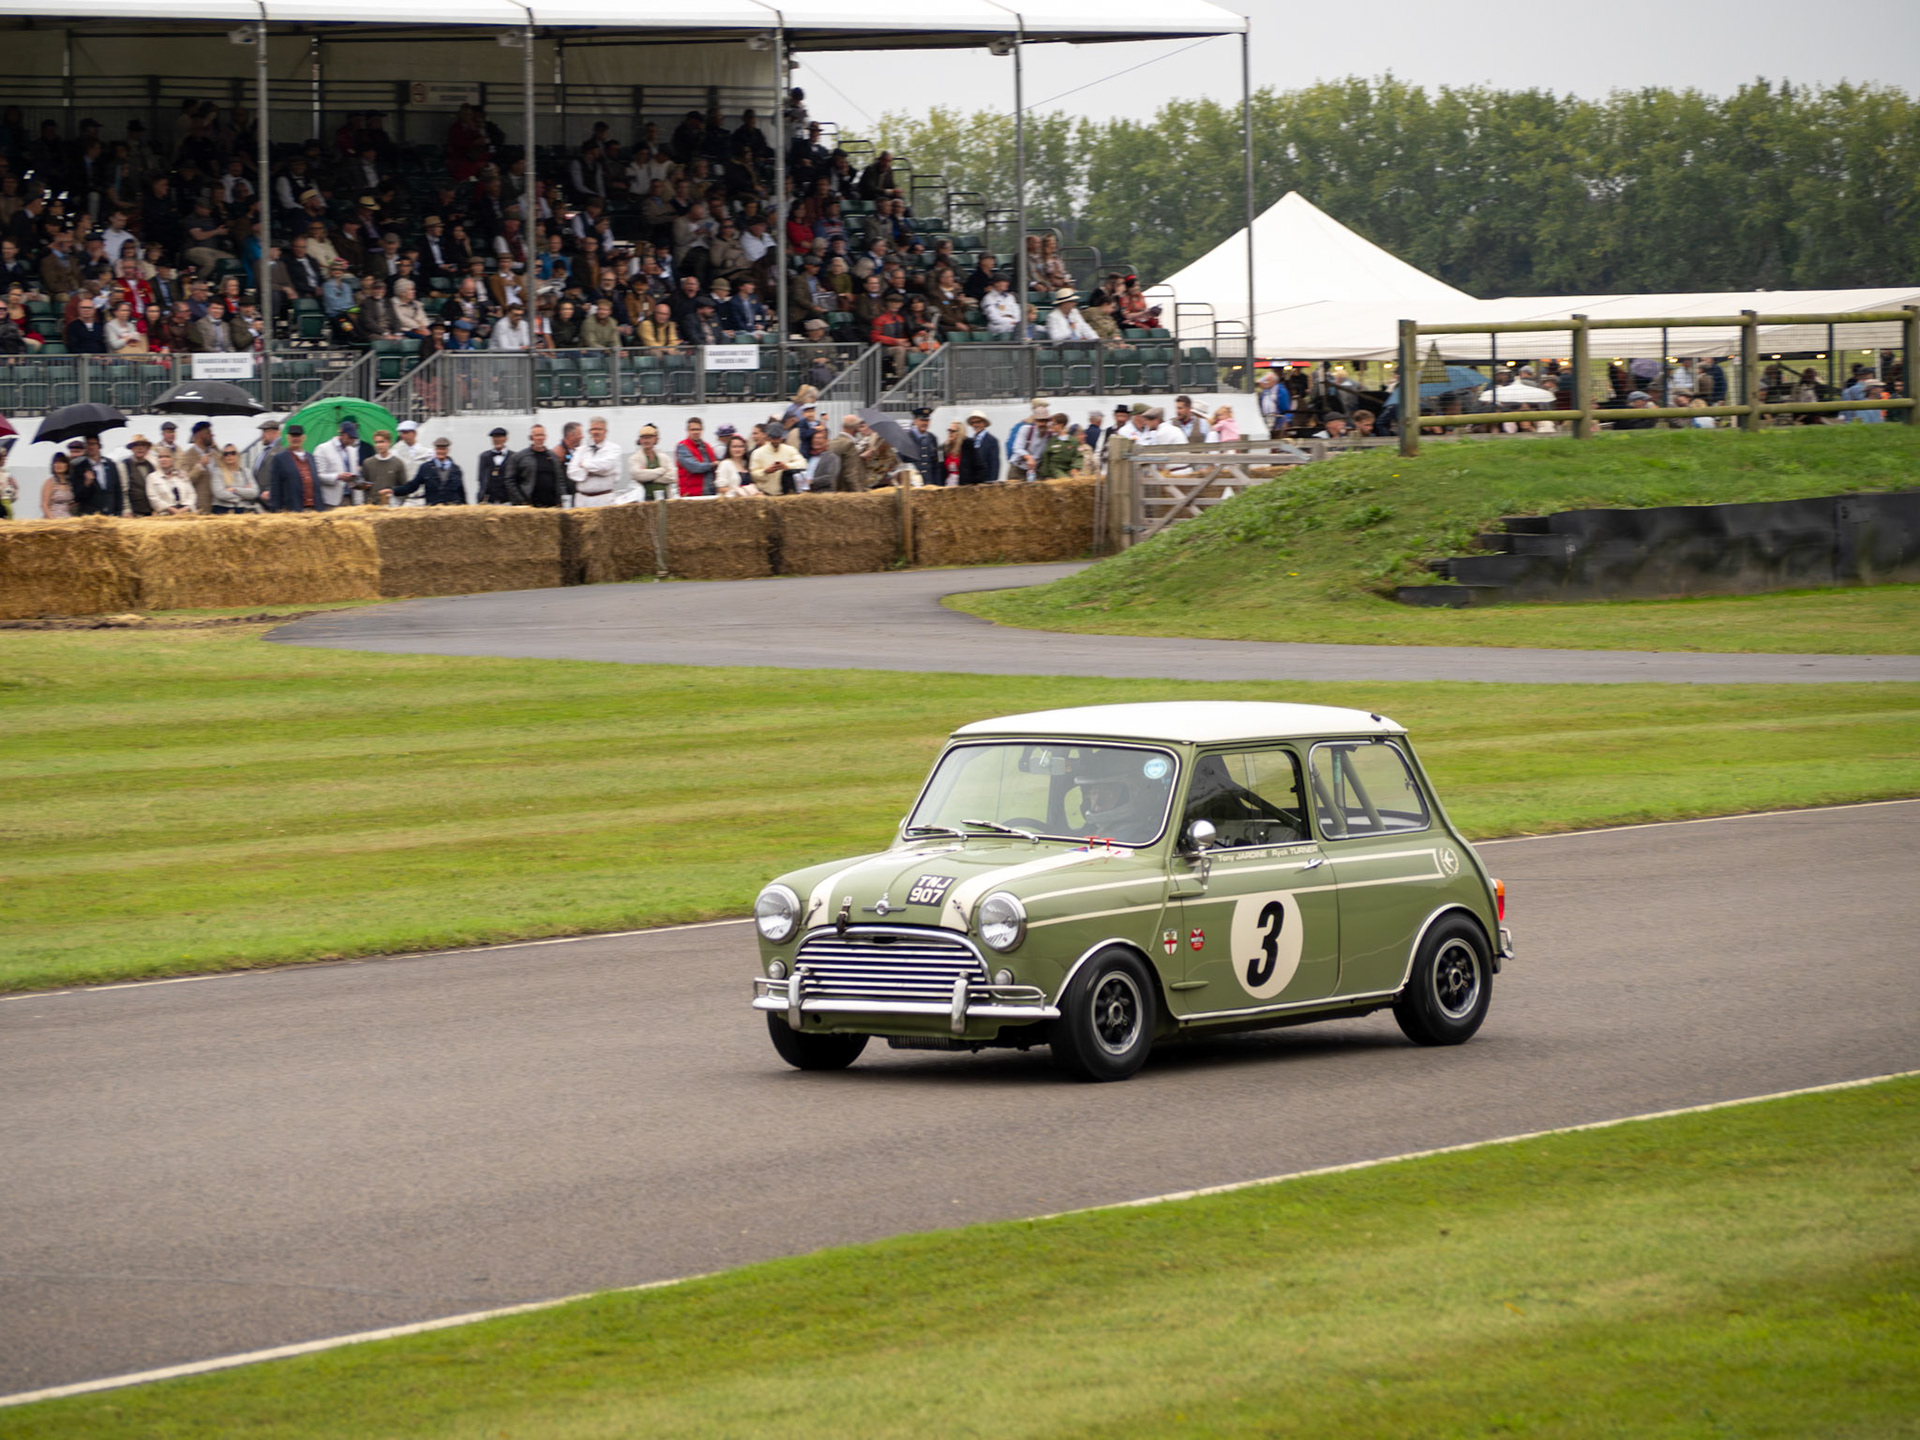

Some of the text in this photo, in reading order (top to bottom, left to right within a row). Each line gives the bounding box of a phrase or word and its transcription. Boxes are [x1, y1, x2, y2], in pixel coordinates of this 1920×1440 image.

[1290, 845, 1318, 855] TURNER
[917, 875, 953, 889] TNJ
[909, 887, 944, 904] 907
[1246, 900, 1285, 988] 3
